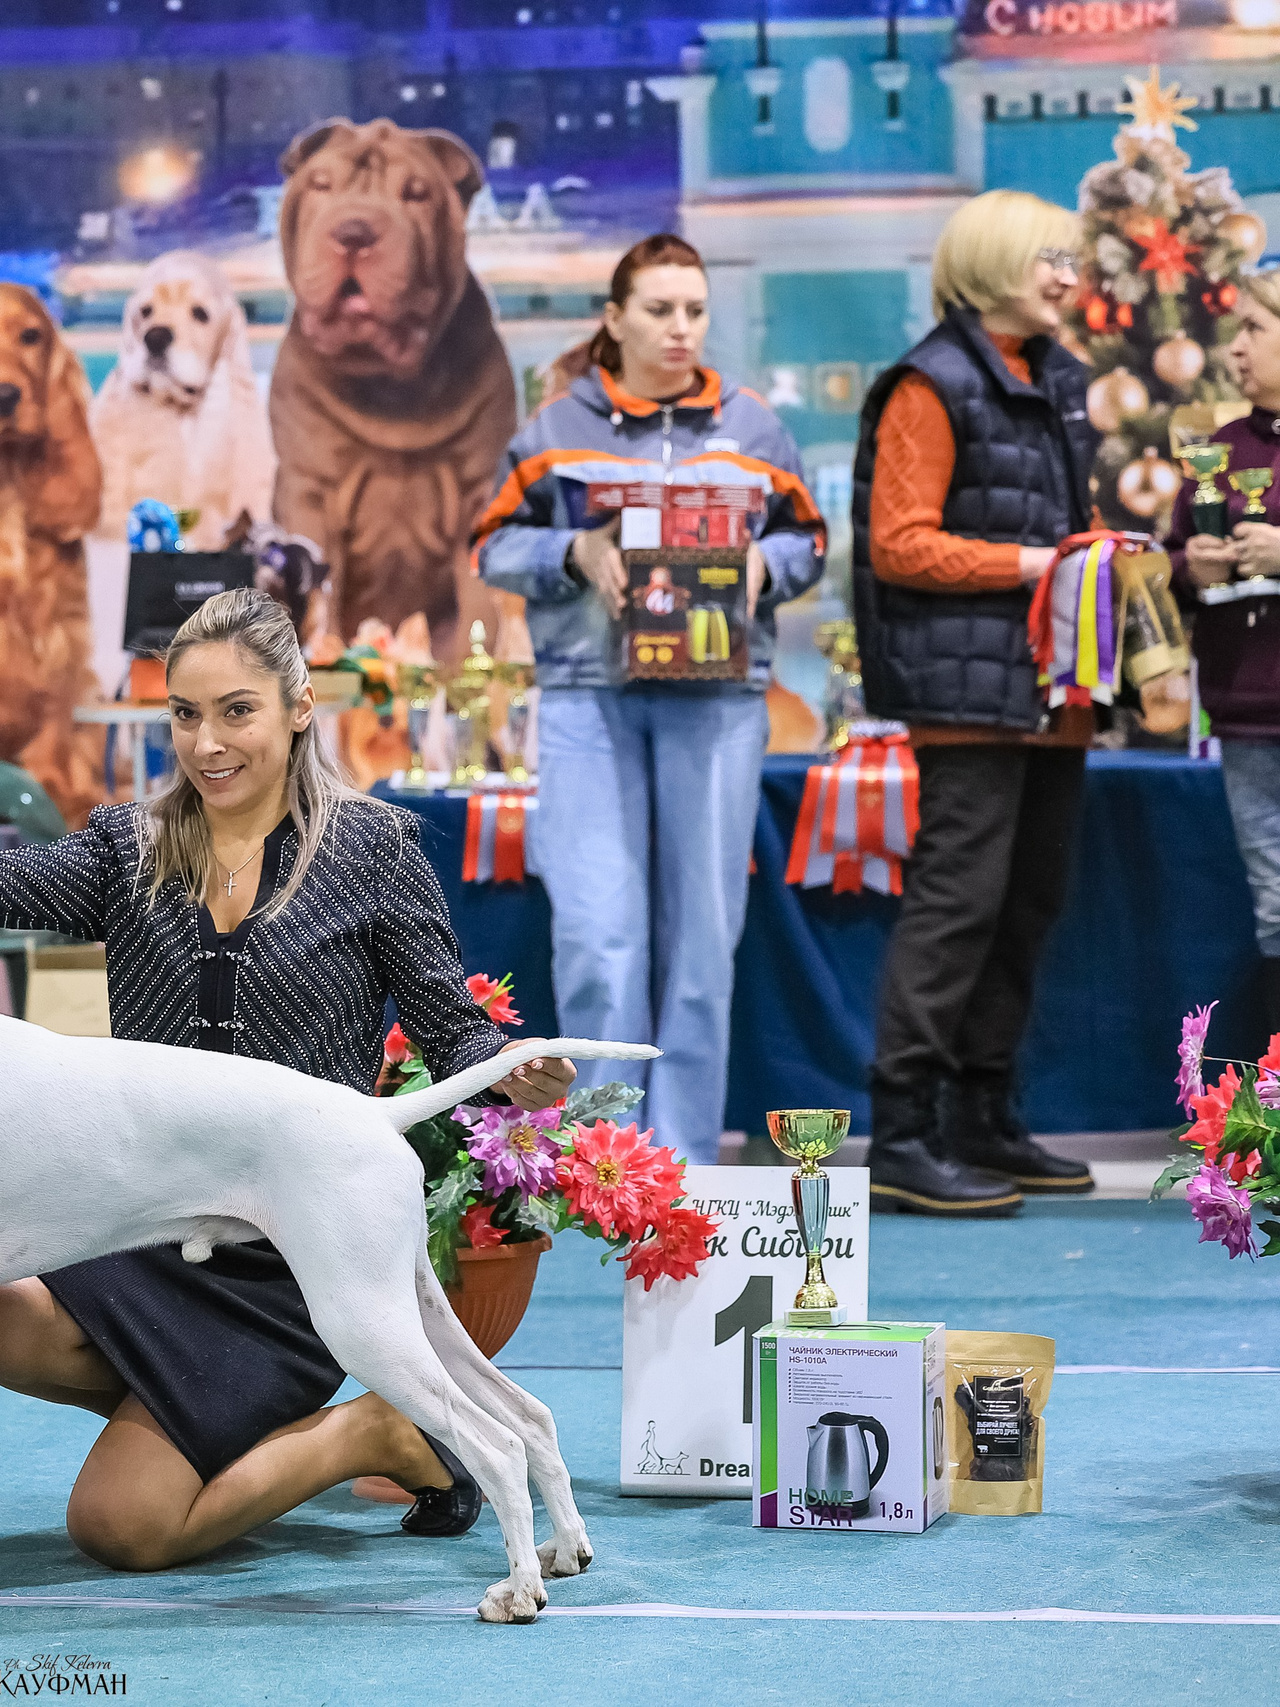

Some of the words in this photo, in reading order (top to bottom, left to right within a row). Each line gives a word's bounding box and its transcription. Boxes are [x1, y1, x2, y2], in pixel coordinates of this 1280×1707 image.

[715, 1275, 773, 1423] 1
[761, 1342, 776, 1350] 1500
[789, 1346, 823, 1355] ЧАЙНИК
[825, 1348, 898, 1357] ЭЛЕКТРИЧЕСКИЙ
[788, 1356, 827, 1364] HS-1010A
[699, 1458, 752, 1477] Drea
[788, 1488, 853, 1506] HOME
[788, 1506, 853, 1527] STAR
